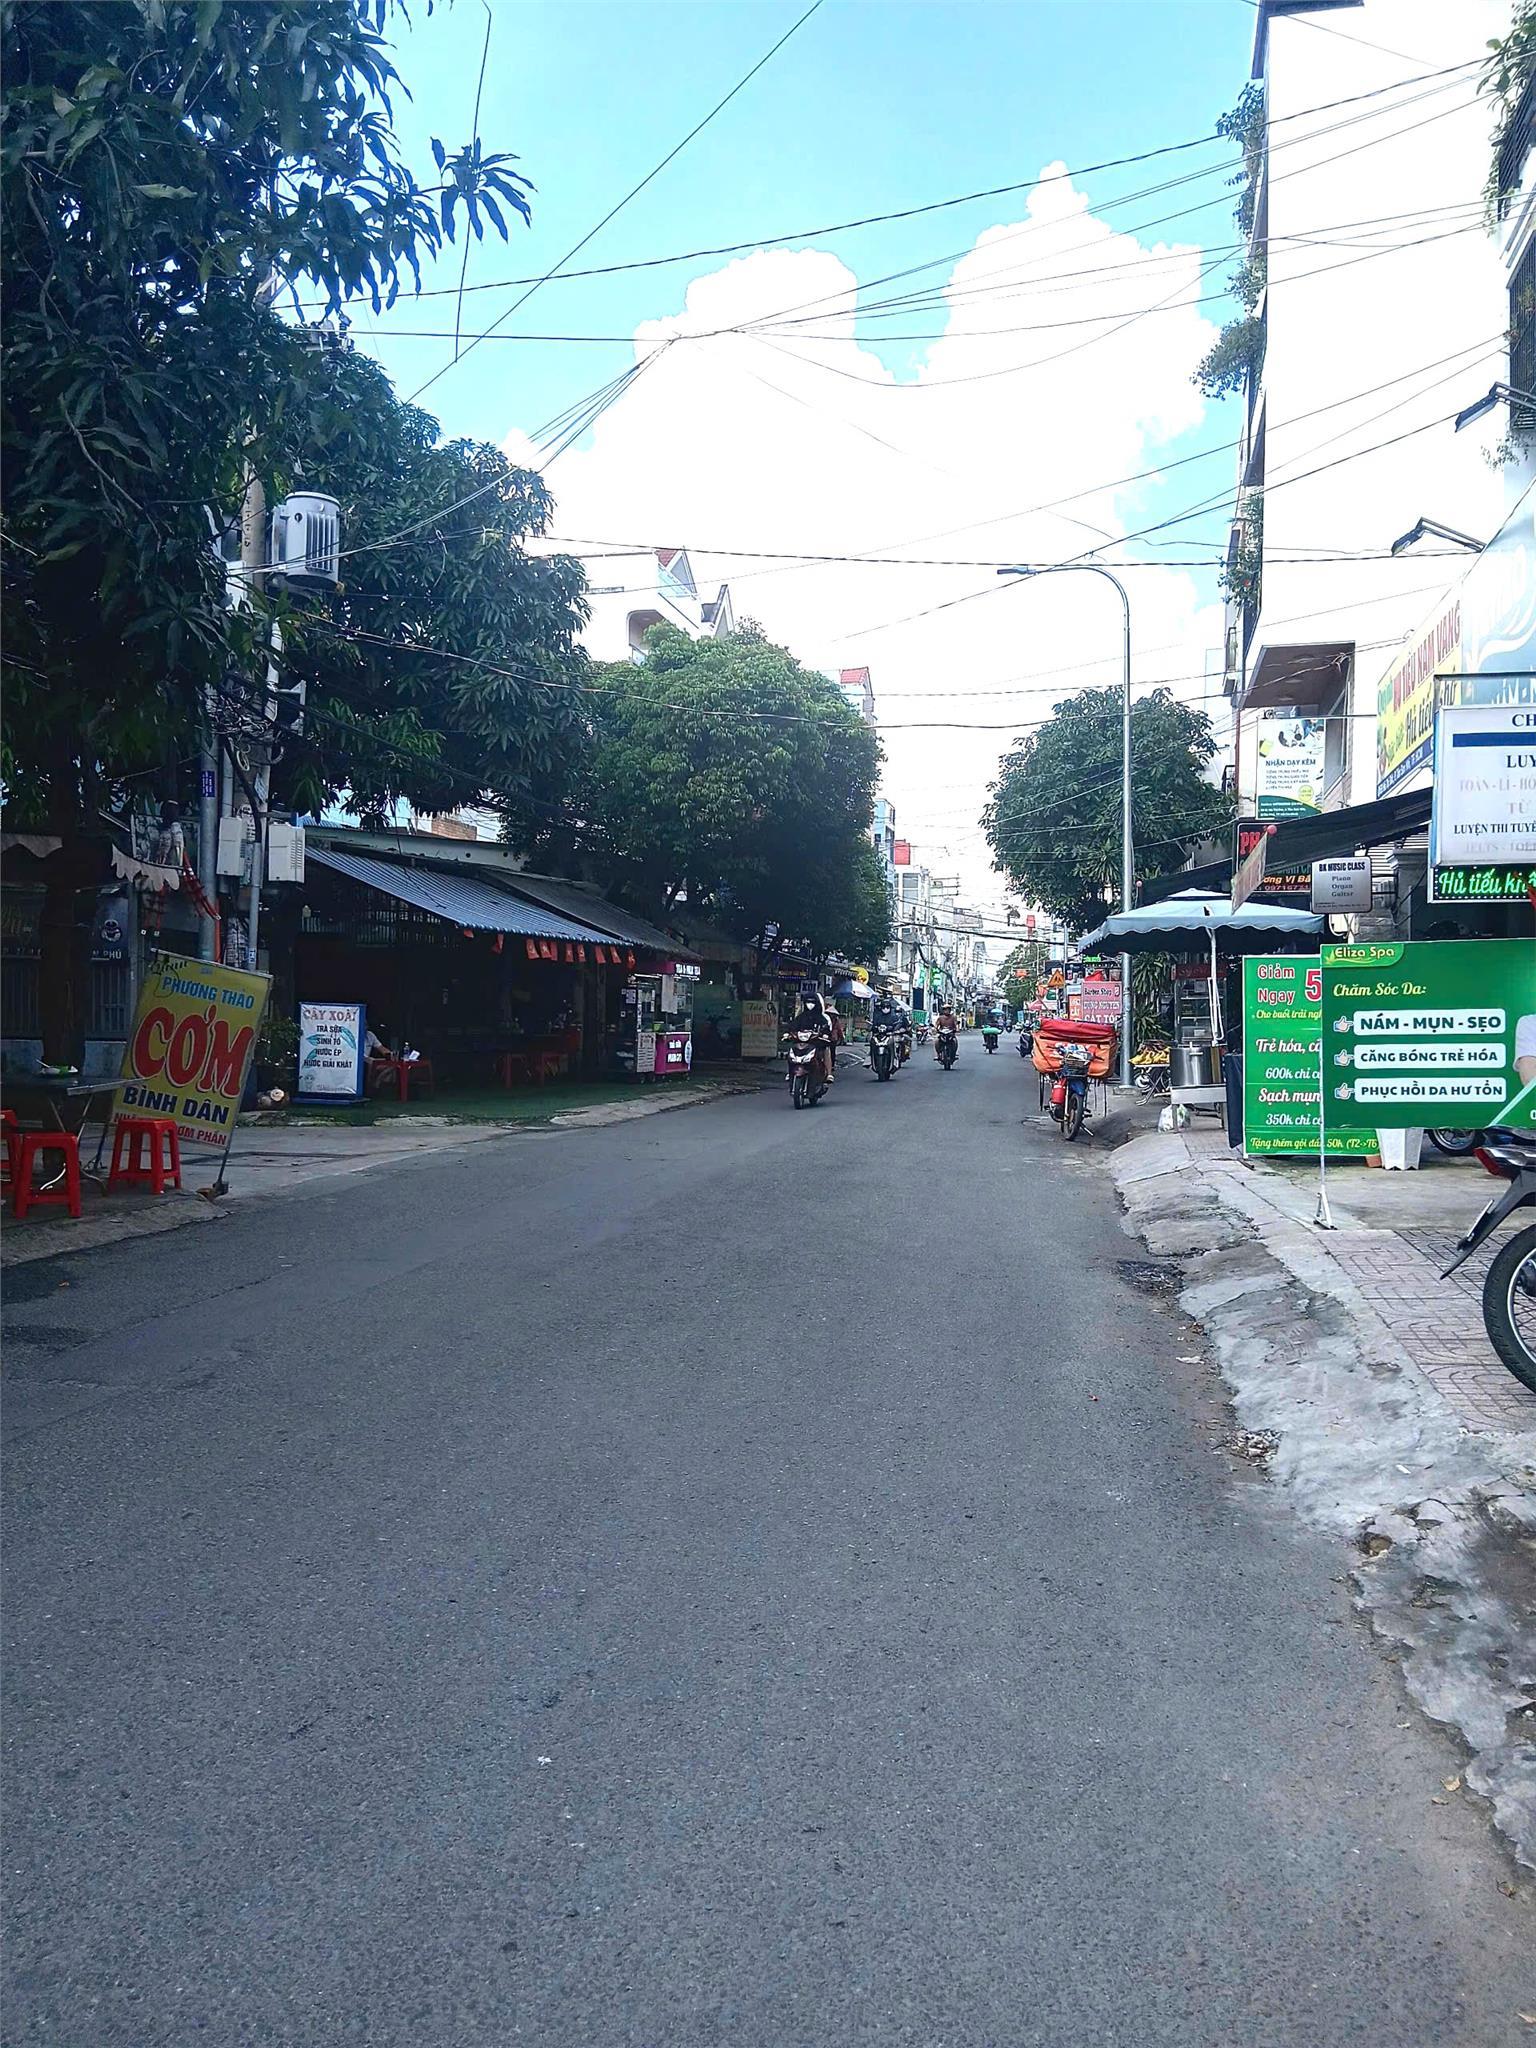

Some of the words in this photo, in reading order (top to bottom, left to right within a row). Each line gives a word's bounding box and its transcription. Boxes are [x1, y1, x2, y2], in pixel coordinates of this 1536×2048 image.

[1417, 630, 1435, 685] NAM
[1437, 600, 1460, 663] VANG
[1406, 705, 1417, 749] Hủ
[1266, 758, 1286, 768] NHẬN
[1287, 758, 1301, 768] DẠY
[1454, 823, 1488, 836] LUYỆN
[1490, 823, 1508, 833] THI
[1328, 862, 1347, 872] MUSIC
[1347, 861, 1365, 871] CLASS
[1439, 870, 1467, 894] Hủ
[1469, 867, 1502, 894] tiếu
[1335, 946, 1366, 958] Eliza
[1370, 946, 1395, 959] Spa
[1257, 964, 1296, 980] Giảm
[162, 975, 217, 1001] PHƯƠNG
[1304, 969, 1322, 1001] 5
[1333, 984, 1372, 997] Chăm
[1375, 982, 1399, 996] Sóc
[1402, 982, 1427, 996] Da:
[1257, 988, 1296, 1005] Ngay
[303, 1007, 326, 1020] CÂY
[329, 1008, 357, 1021] XOÀI
[1256, 1009, 1271, 1019] Cho
[1291, 1008, 1308, 1019] trải
[316, 1024, 328, 1032] TRÀ
[1360, 1013, 1399, 1030] NÁM
[1413, 1016, 1454, 1033] MỤN
[1467, 1016, 1501, 1033] SẸO
[317, 1037, 331, 1045] SINH
[1255, 1037, 1277, 1053] Trẻ
[1279, 1038, 1306, 1054] hóa,
[132, 1004, 256, 1099] CƠM
[1360, 1050, 1396, 1062] CĂNG
[1399, 1048, 1437, 1062] BÓNG
[1440, 1048, 1465, 1061] TRẺ
[1468, 1048, 1498, 1061] HÓA
[1266, 1067, 1293, 1080] 600k
[1294, 1067, 1311, 1079] chỉ
[1258, 1088, 1291, 1106] Sạch
[1292, 1092, 1321, 1106] mụn
[1361, 1086, 1397, 1099] PHỤC
[1400, 1081, 1425, 1096] HỒI
[1429, 1086, 1448, 1096] DA
[1450, 1085, 1472, 1095] HƯ
[1474, 1080, 1503, 1095] TỔN
[123, 1084, 178, 1114] BÌNH
[182, 1098, 230, 1125] DÂN
[1266, 1114, 1293, 1126] 350k
[1294, 1113, 1311, 1125] chỉ
[1250, 1138, 1271, 1150] Tặng
[1272, 1138, 1293, 1148] thêm
[1294, 1138, 1308, 1150] gội
[1326, 1138, 1344, 1148] 50k
